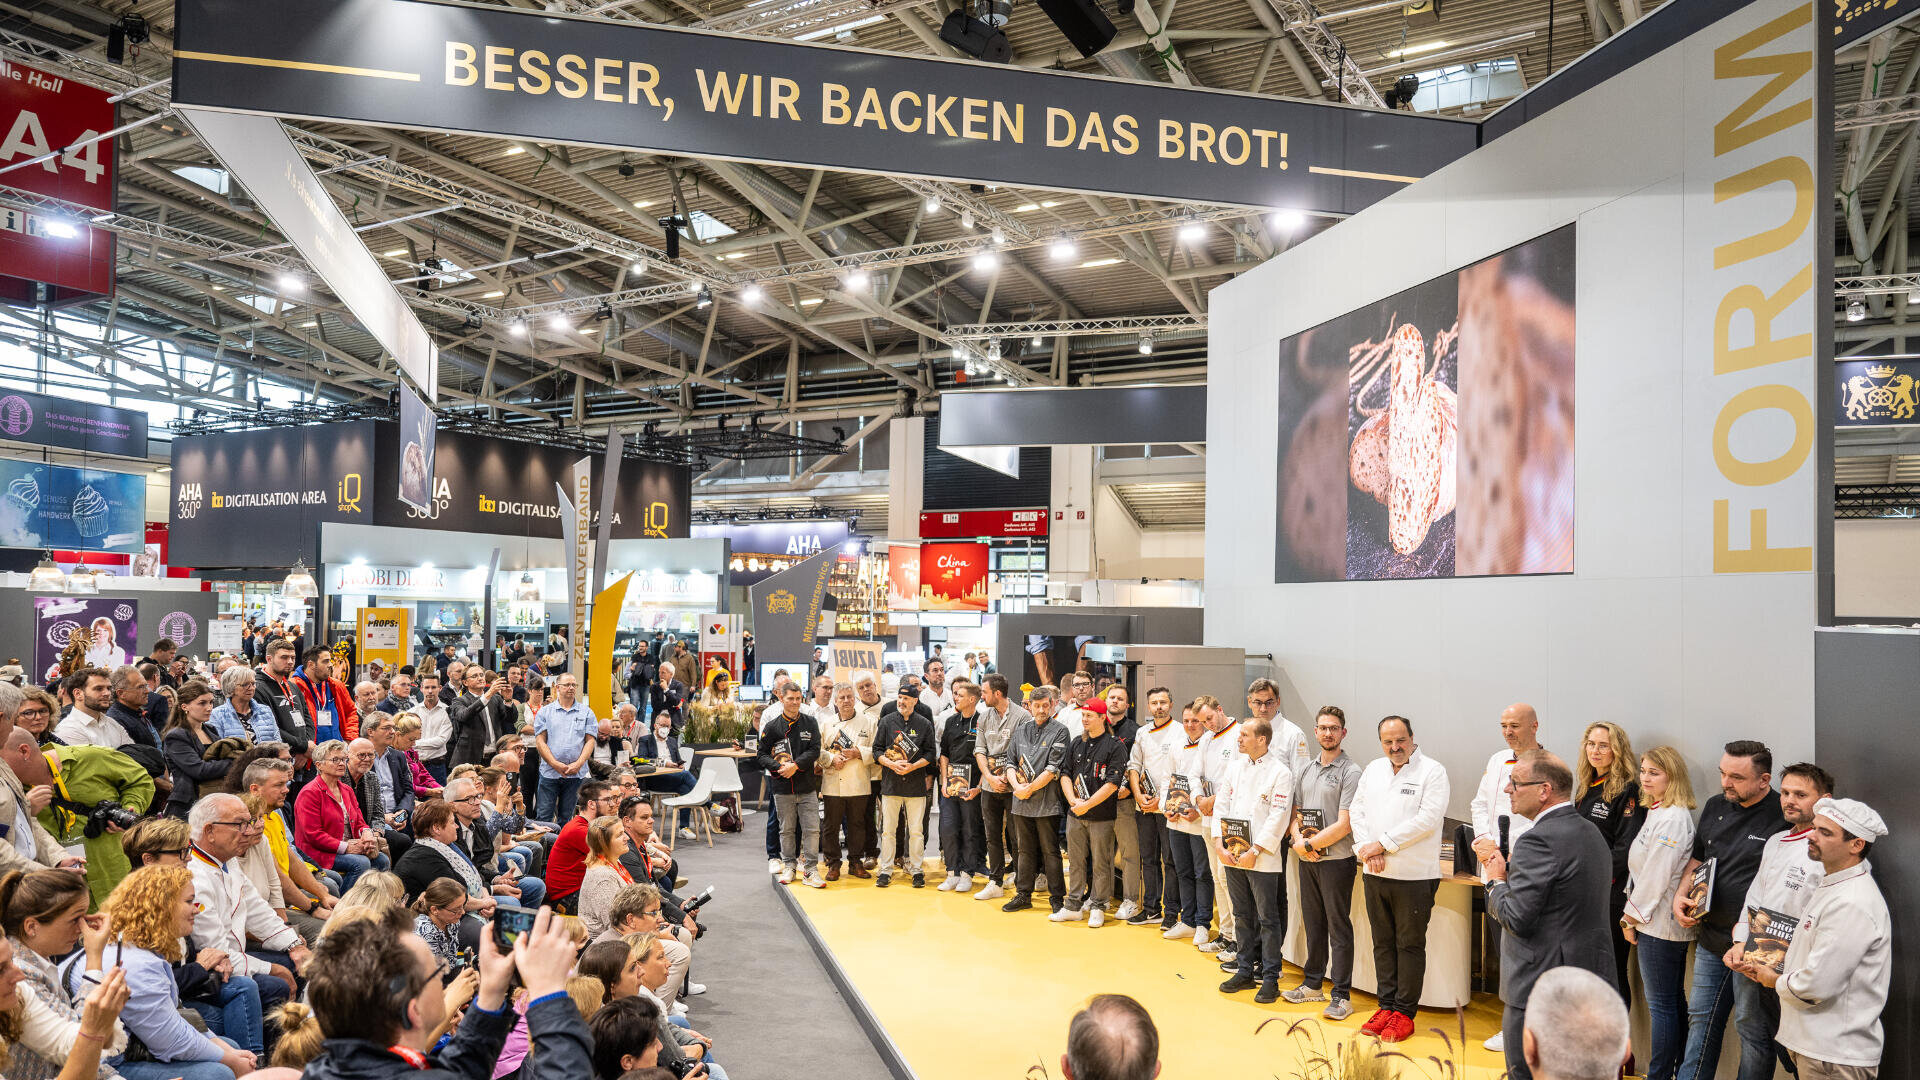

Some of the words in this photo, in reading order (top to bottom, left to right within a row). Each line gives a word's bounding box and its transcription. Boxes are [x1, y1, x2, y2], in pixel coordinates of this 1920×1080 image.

[27, 71, 64, 94] Hall
[444, 41, 675, 122] BESSER,
[694, 67, 801, 122] WIR
[820, 82, 1025, 144] BACKEN
[1045, 107, 1140, 156] DAS
[1158, 119, 1290, 171] BROT!
[0, 109, 105, 184] A4
[1712, 1, 1814, 574] FORUM
[178, 482, 203, 501] AHA
[225, 493, 299, 508] DIGITALISATION
[301, 490, 327, 504] AREA
[38, 511, 71, 520] HANDWERK
[177, 500, 201, 519] 360°
[337, 503, 352, 514] shop
[786, 535, 822, 555] AHA
[573, 474, 590, 660] ZENTRALVERBAND
[937, 554, 972, 568] China
[802, 560, 830, 643] Mitgliederservice
[1765, 927, 1793, 941] BIBE
[1770, 920, 1795, 933] BRO
